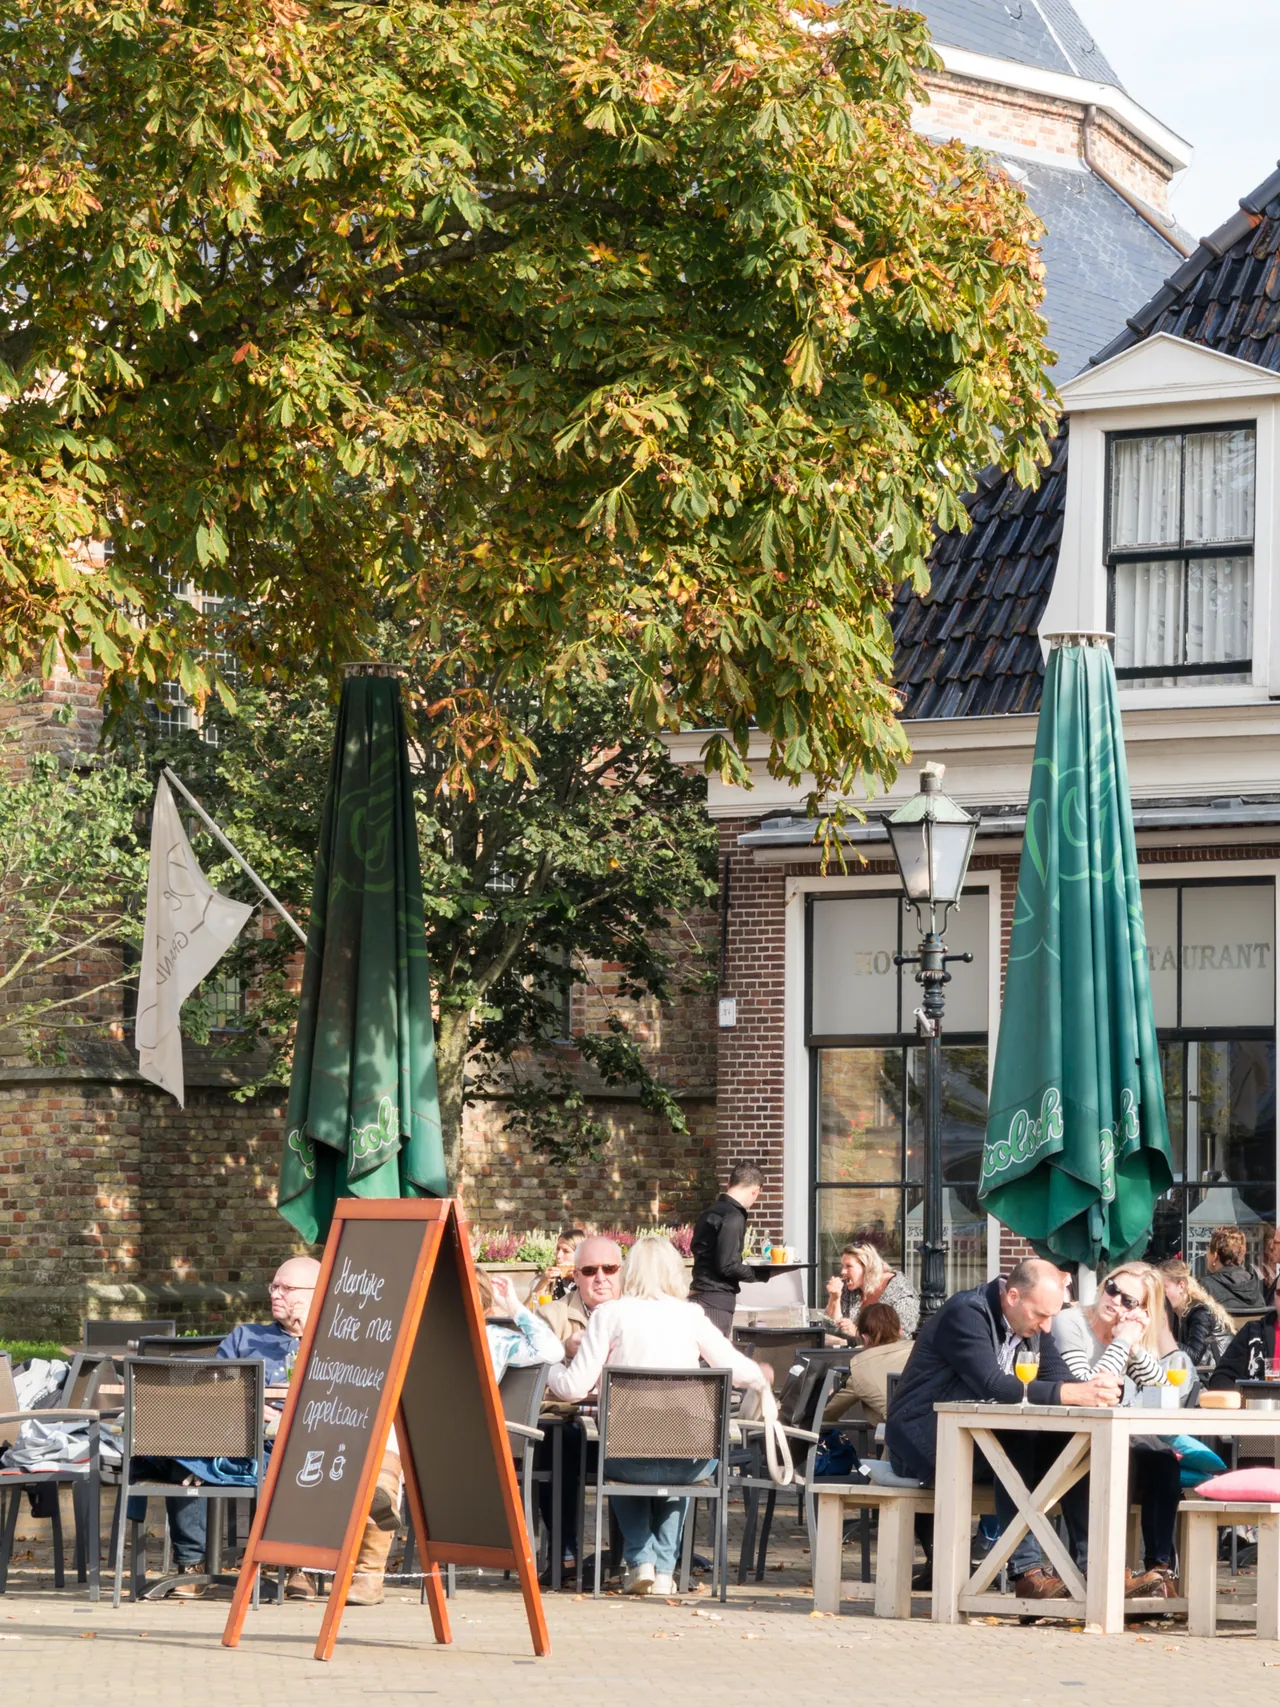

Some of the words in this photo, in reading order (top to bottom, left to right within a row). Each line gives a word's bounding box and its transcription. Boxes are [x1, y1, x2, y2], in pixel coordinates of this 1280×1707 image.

[1147, 942, 1271, 971] TAURANT
[979, 1087, 1064, 1185] rolsch
[334, 1256, 385, 1310] Heerlijke
[308, 1350, 385, 1395] huisgemaakte
[302, 1396, 369, 1433] appeltaart
